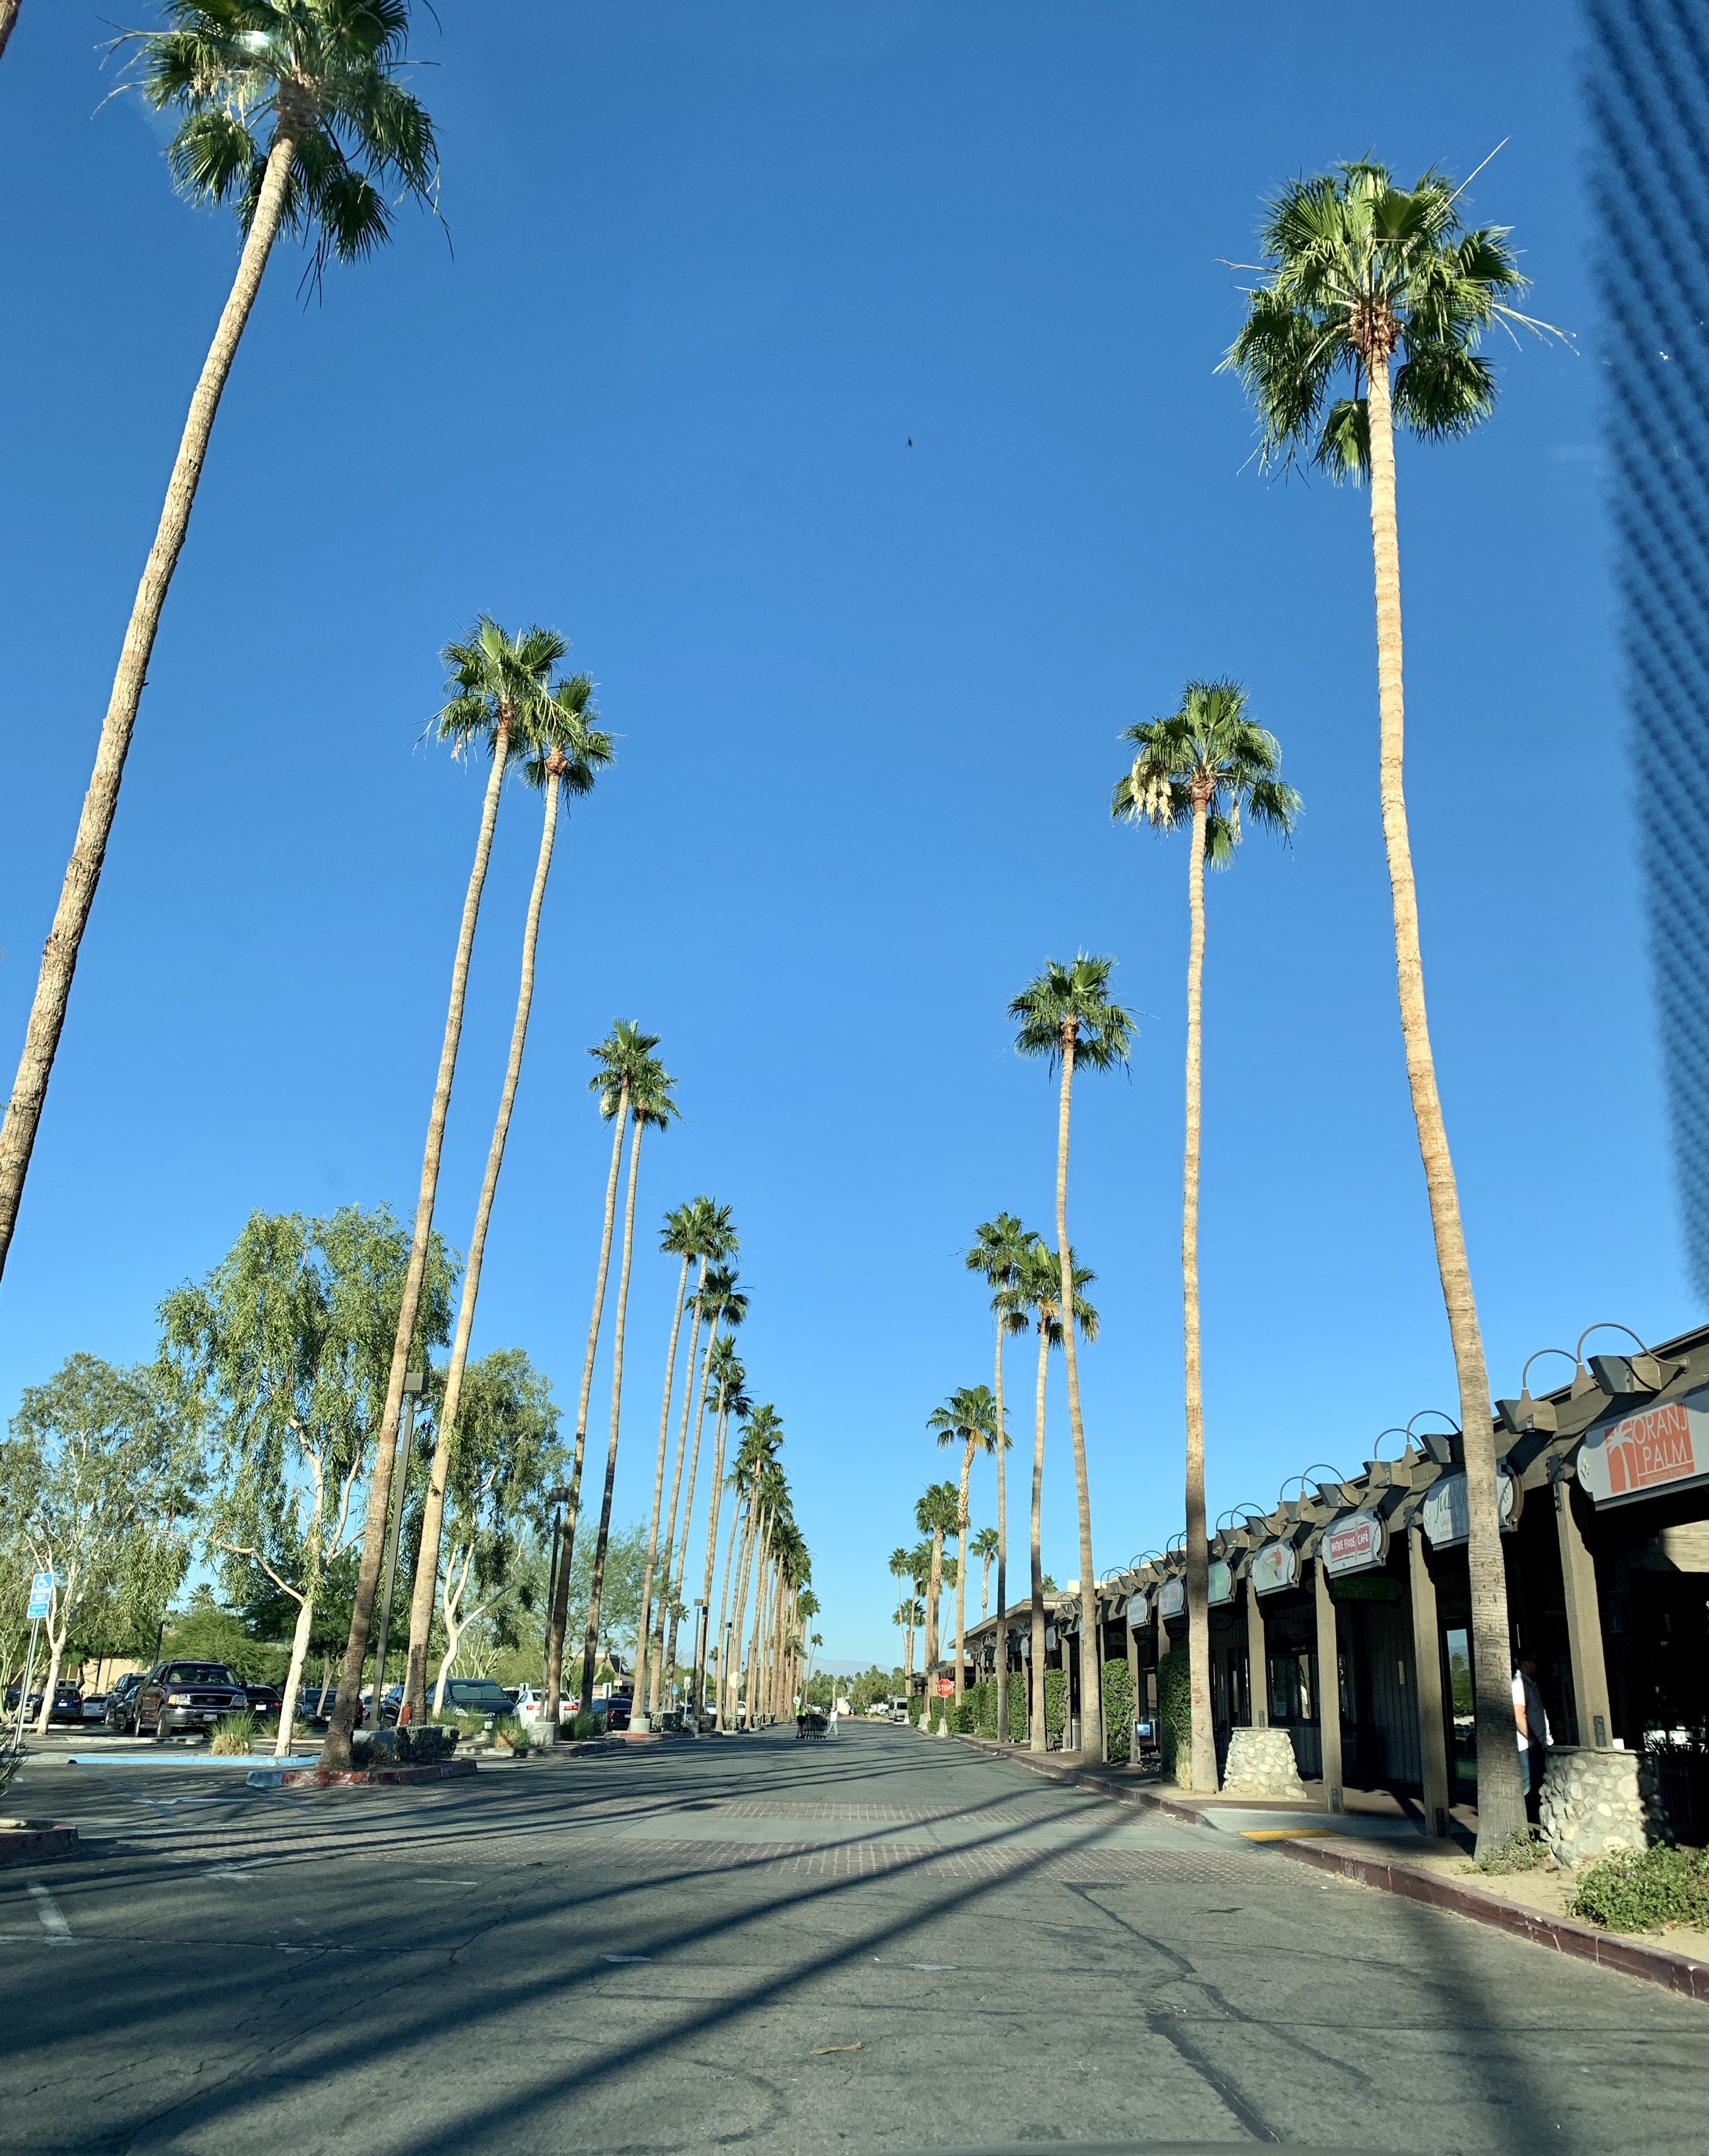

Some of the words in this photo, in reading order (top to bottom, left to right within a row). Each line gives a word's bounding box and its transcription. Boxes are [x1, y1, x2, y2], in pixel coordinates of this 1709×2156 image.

[1633, 1405, 1688, 1444] ORANJ
[1643, 1436, 1688, 1472] PALM
[1331, 1540, 1344, 1552] NATIVE
[1344, 1536, 1355, 1549] FOODS
